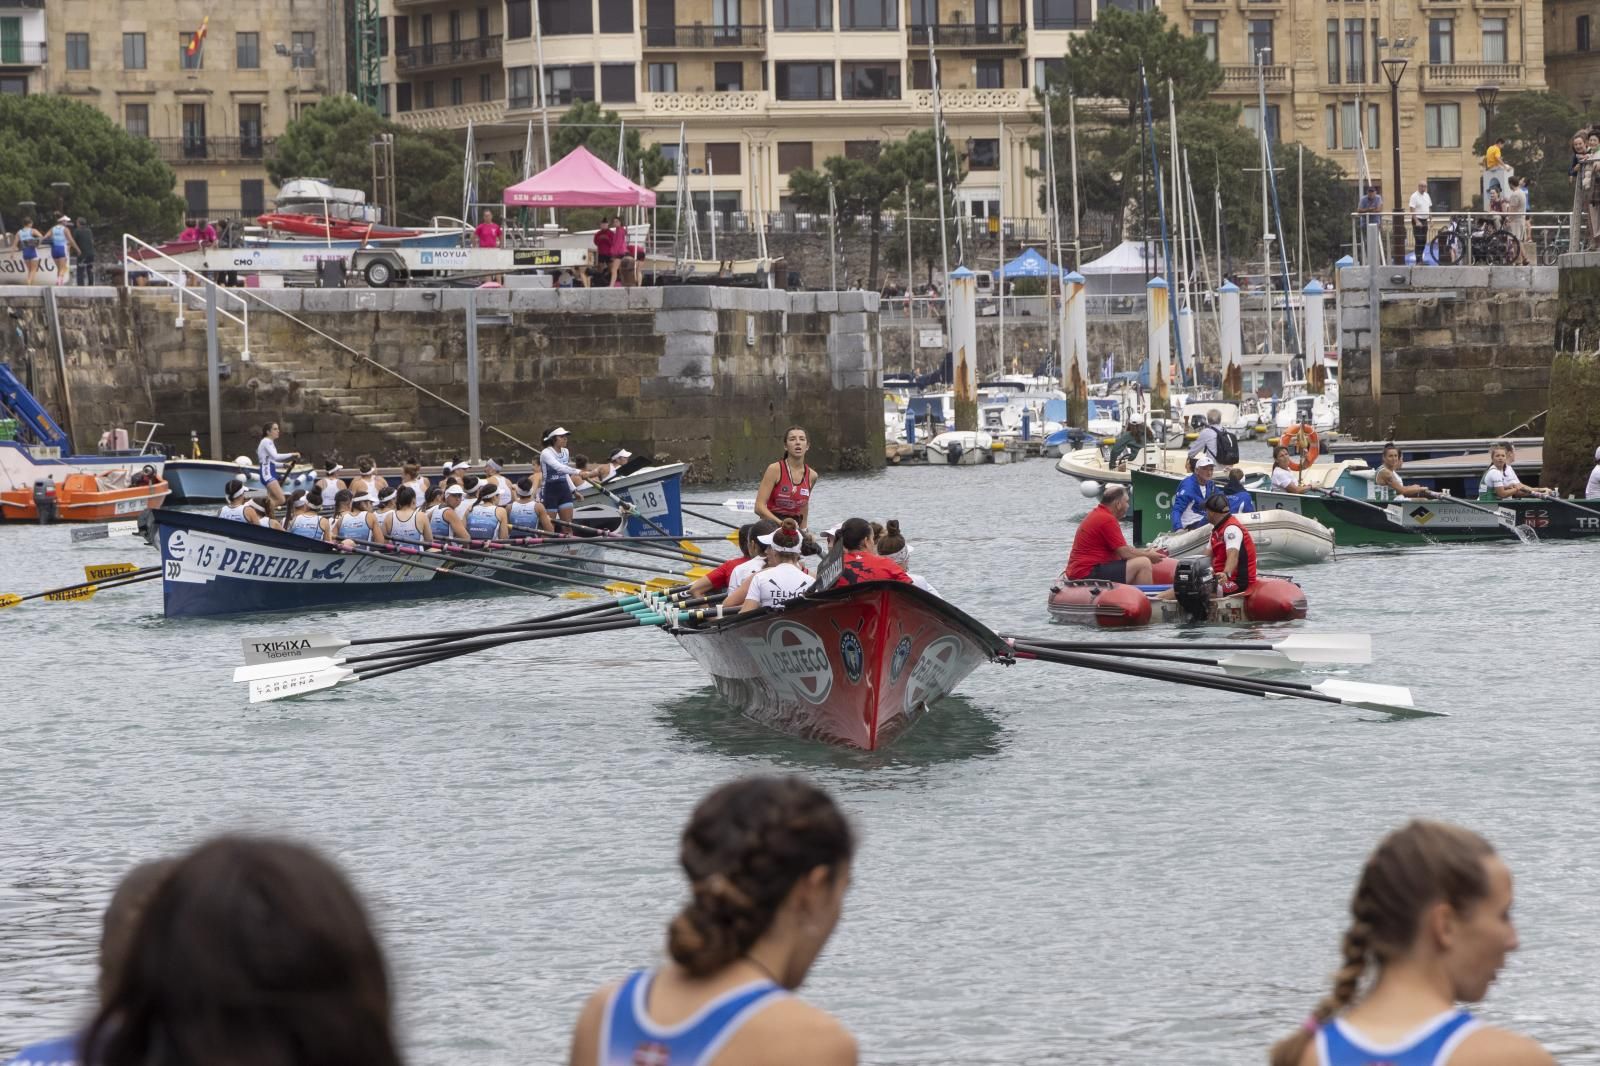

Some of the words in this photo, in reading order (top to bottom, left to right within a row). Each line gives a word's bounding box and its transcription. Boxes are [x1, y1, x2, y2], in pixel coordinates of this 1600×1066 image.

[534, 252, 559, 265] bike
[642, 491, 658, 509] 18
[1539, 509, 1550, 518] 2
[1539, 519, 1550, 528] 2
[197, 543, 215, 568] 15
[217, 548, 311, 580] PEREIRA
[251, 639, 312, 653] TXIKIXA
[266, 650, 302, 659] Taberna
[772, 646, 829, 674] DELTECO
